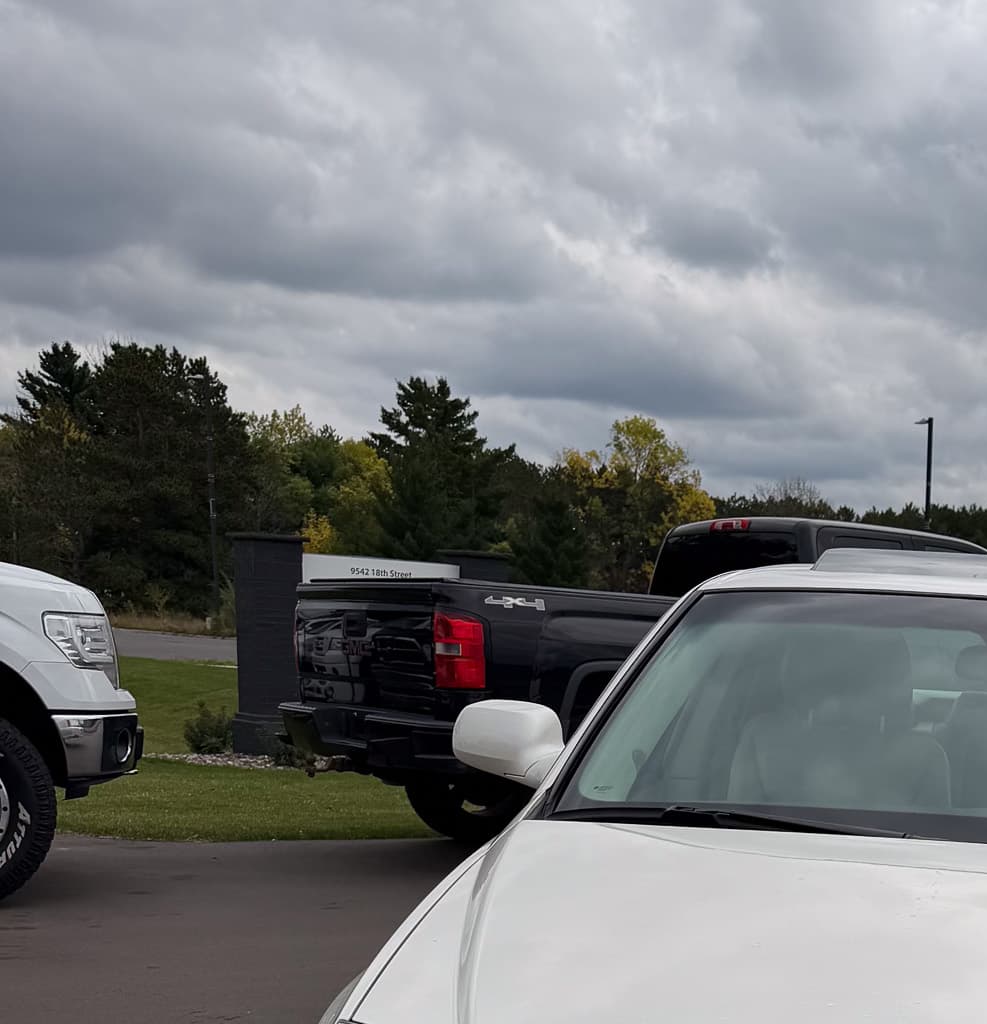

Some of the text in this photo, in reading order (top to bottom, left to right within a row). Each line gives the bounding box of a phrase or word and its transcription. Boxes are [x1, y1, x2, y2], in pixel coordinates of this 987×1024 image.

[350, 567, 412, 578] 9542 18th Street
